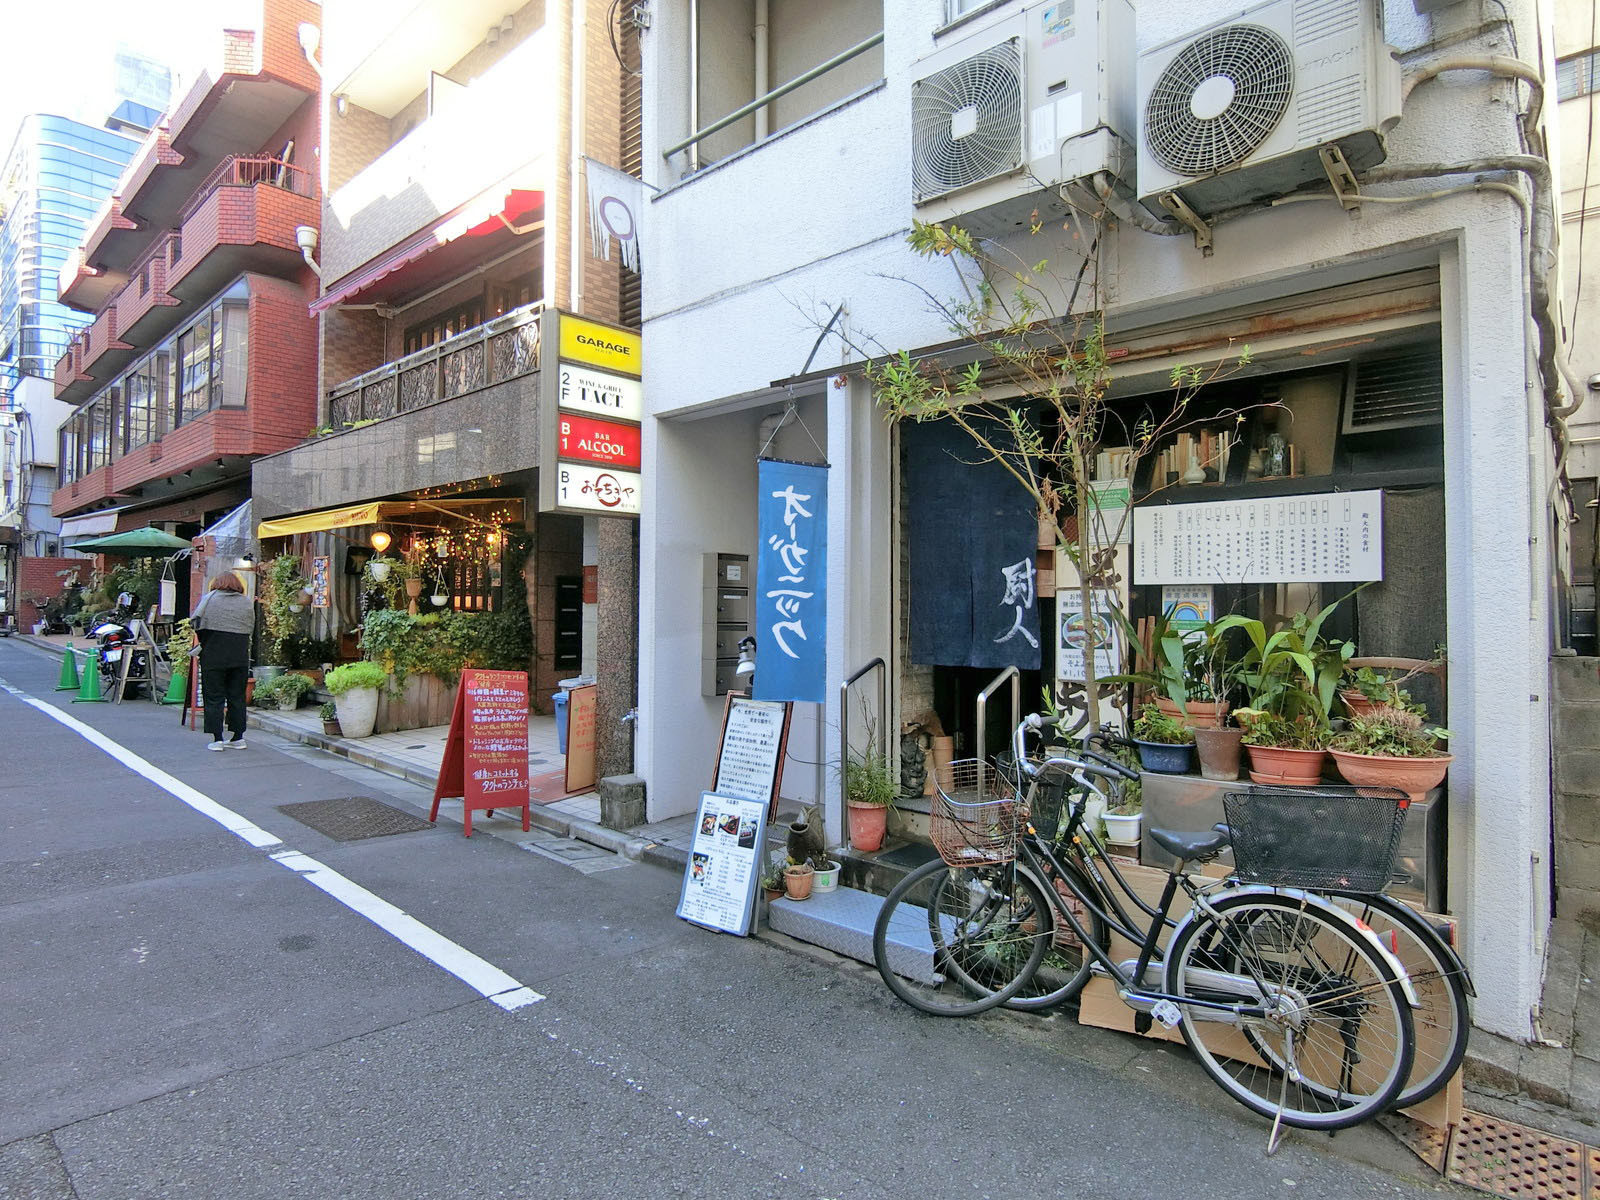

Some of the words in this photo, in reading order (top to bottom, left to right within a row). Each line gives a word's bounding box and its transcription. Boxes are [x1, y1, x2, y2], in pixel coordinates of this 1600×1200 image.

[1296, 46, 1359, 70] HITACHI
[576, 335, 631, 355] GARAGE
[578, 386, 624, 409] TACT
[594, 432, 610, 441] BAR
[577, 439, 626, 456] ALCOOL
[766, 485, 814, 659] オーガニック
